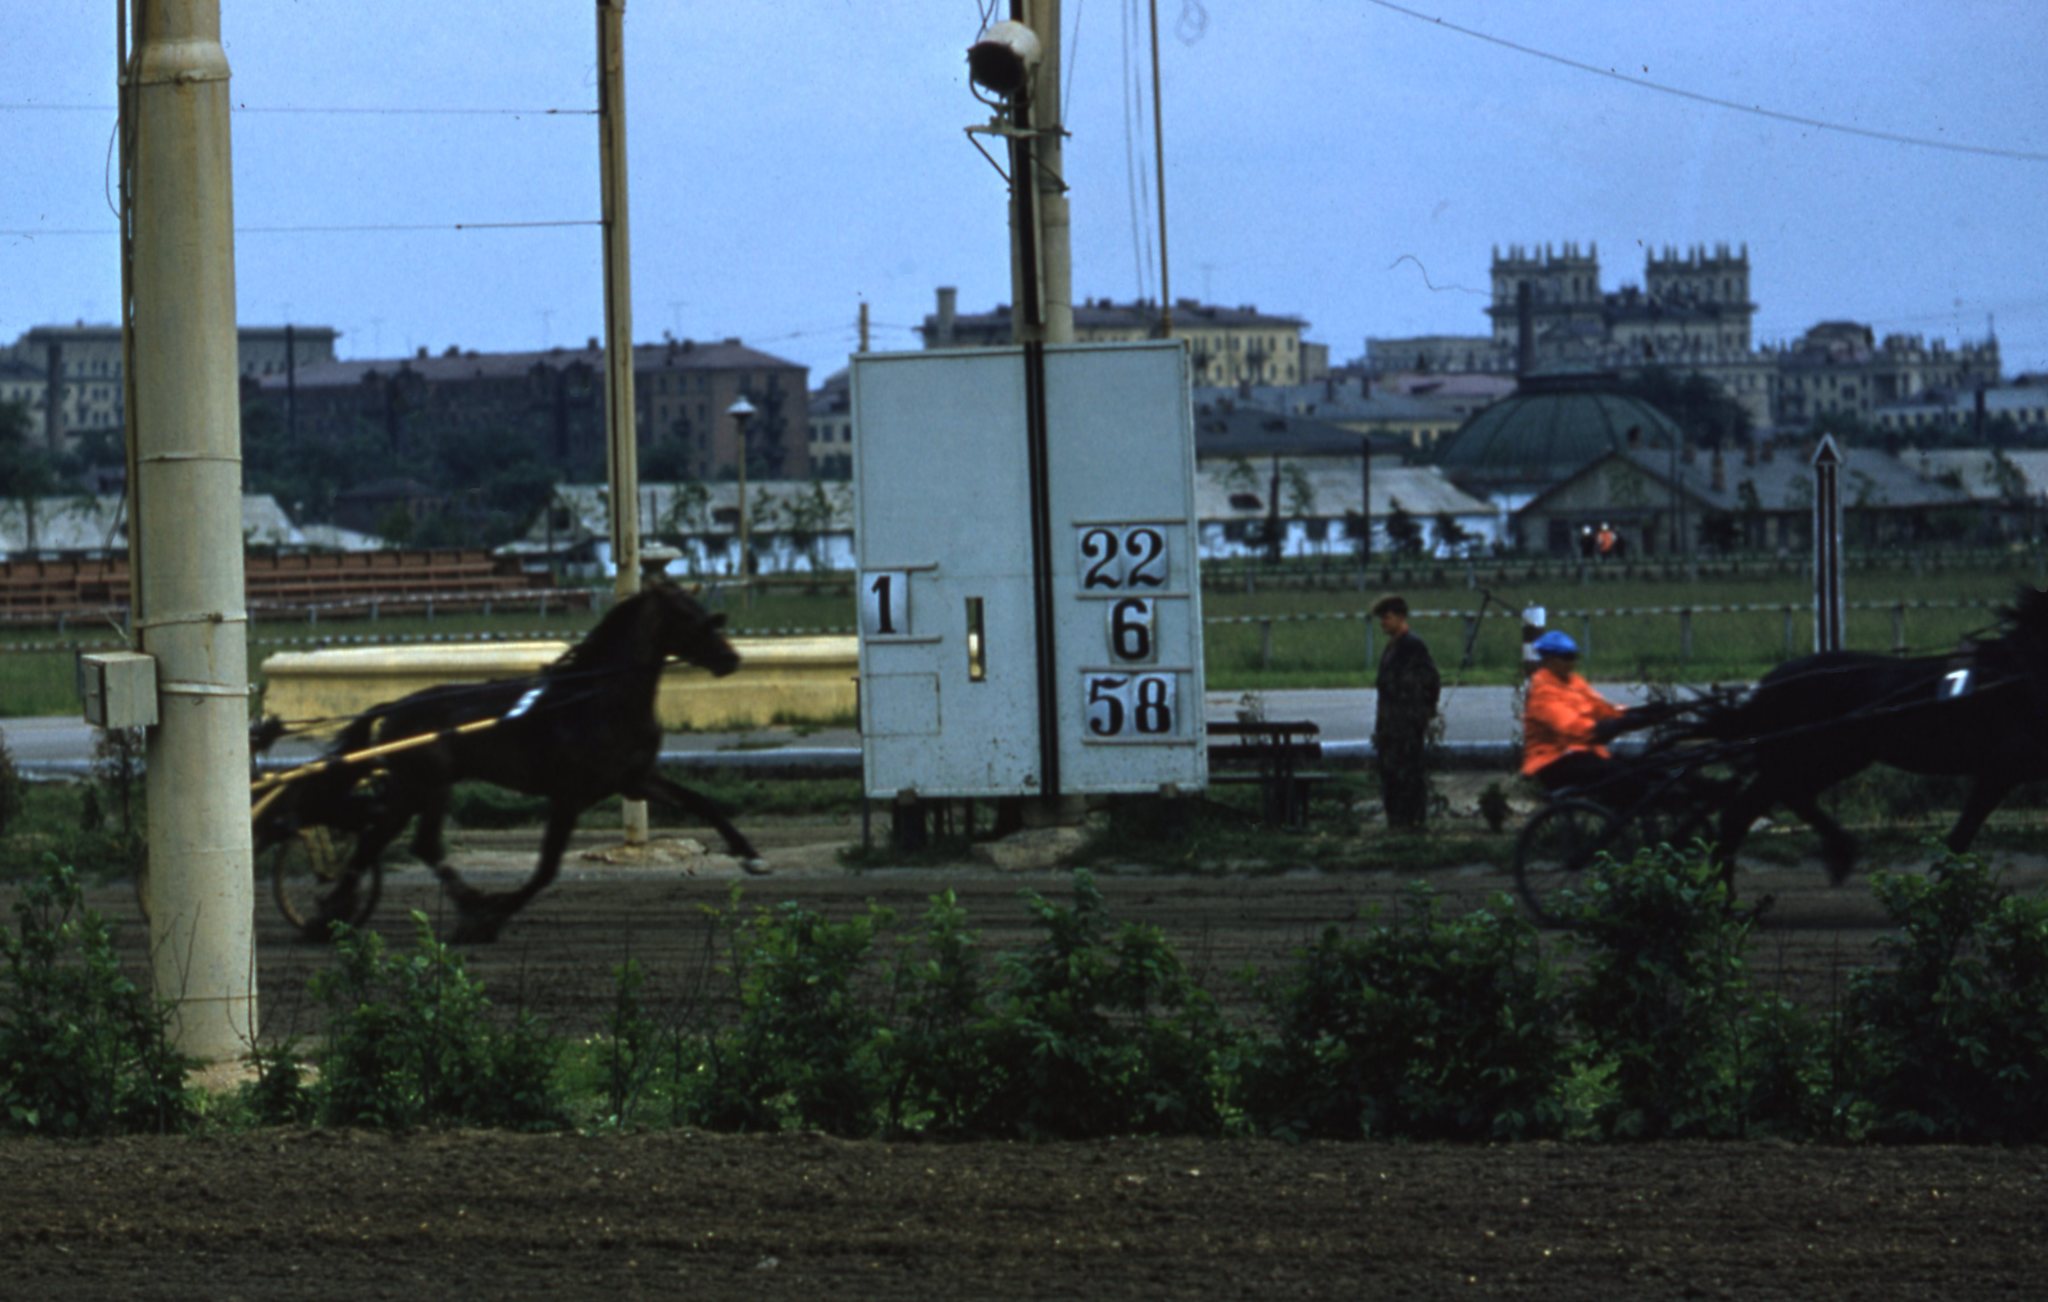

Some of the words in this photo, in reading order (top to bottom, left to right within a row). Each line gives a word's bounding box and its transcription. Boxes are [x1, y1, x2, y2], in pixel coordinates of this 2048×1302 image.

[1081, 529, 1164, 589] 22
[872, 576, 896, 634] 1
[1112, 598, 1150, 661] 6
[1088, 678, 1171, 737] 58
